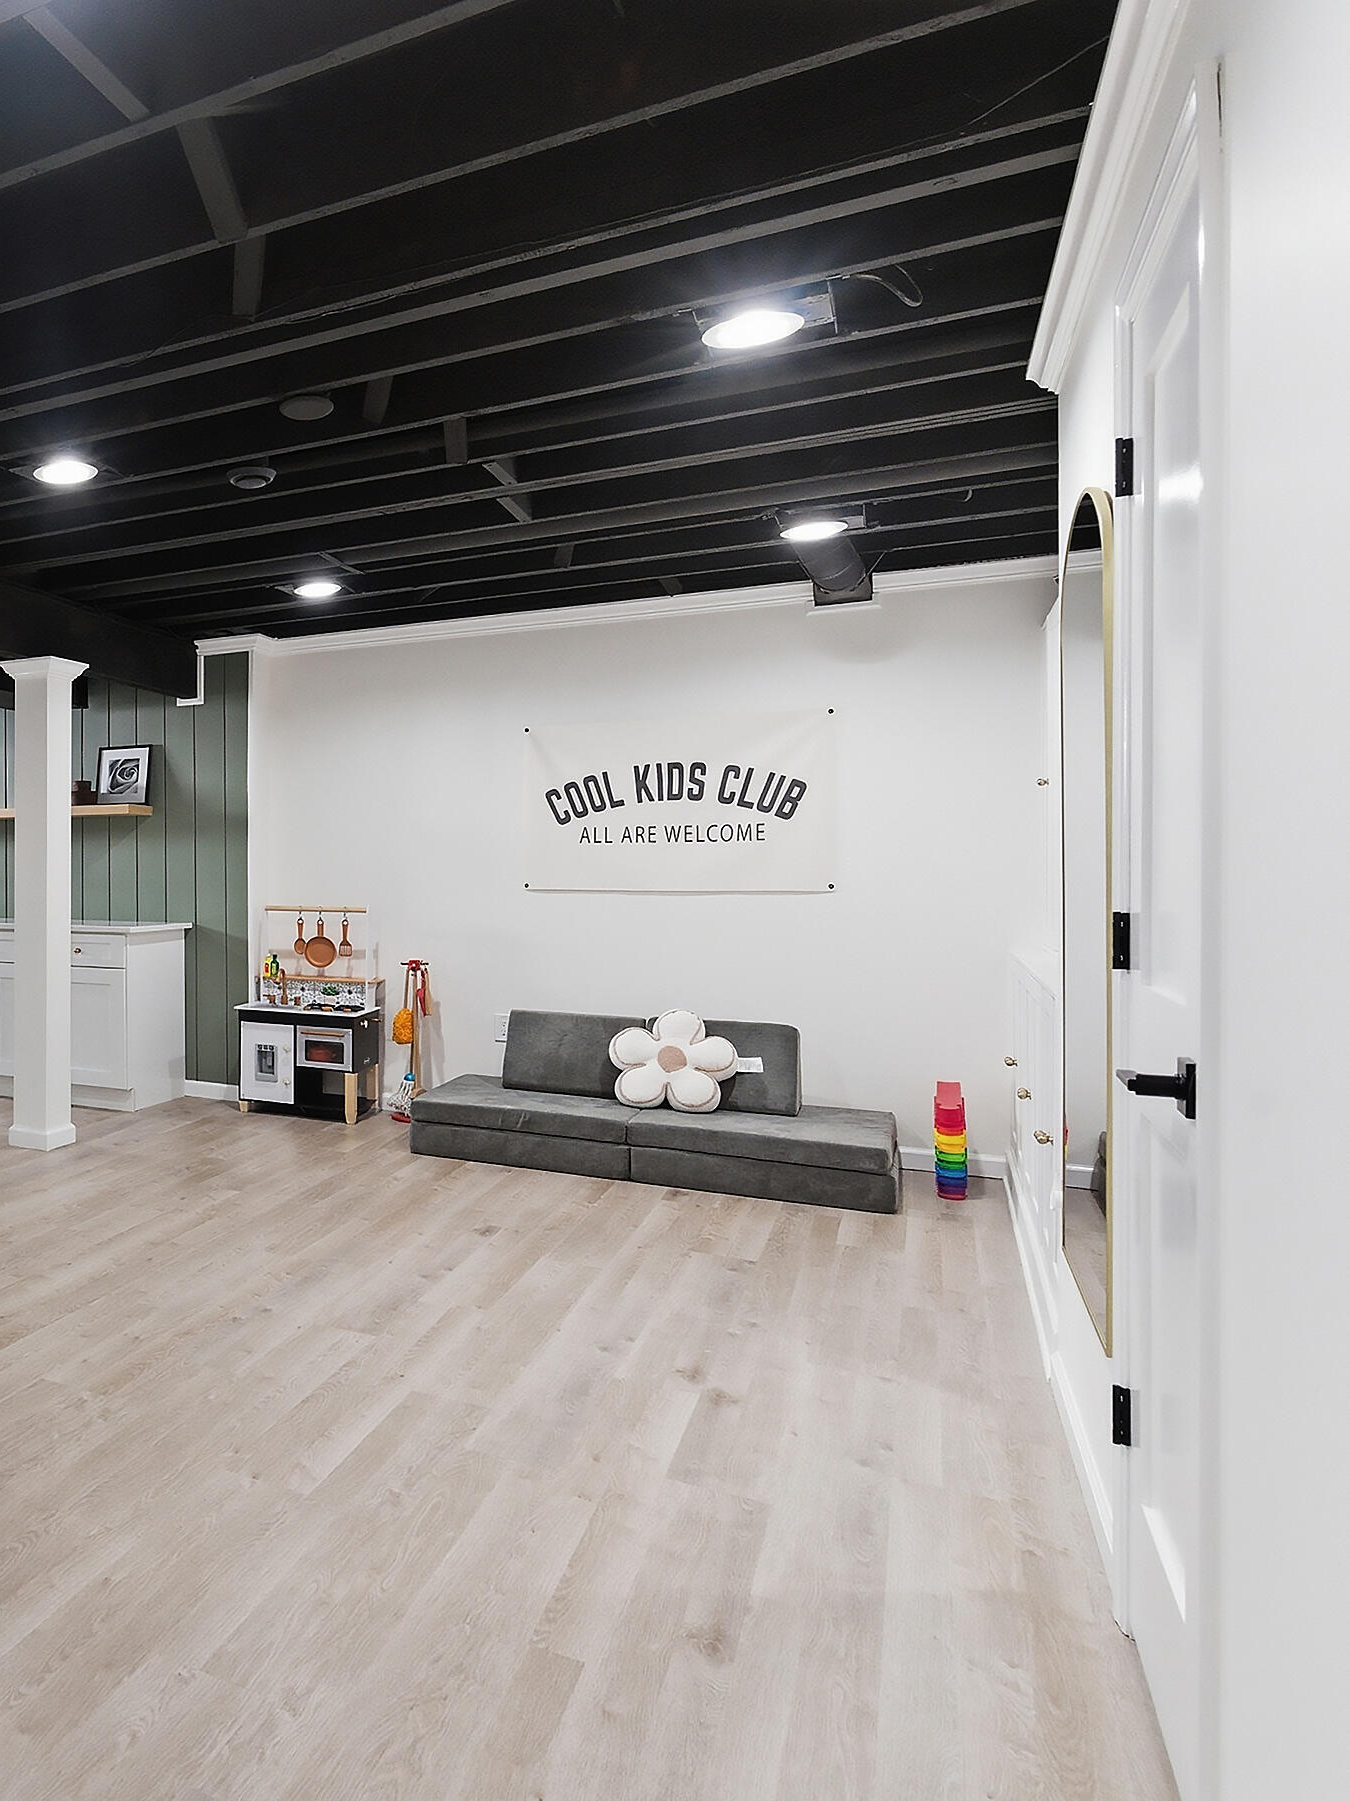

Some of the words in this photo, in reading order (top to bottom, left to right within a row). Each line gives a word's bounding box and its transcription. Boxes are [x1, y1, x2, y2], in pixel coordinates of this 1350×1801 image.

[545, 771, 626, 826] COOL
[633, 761, 707, 804] KIDS
[717, 764, 808, 821] CLUB
[579, 826, 613, 844] ALL
[621, 825, 657, 844] ARE
[664, 822, 766, 843] WELCOME
